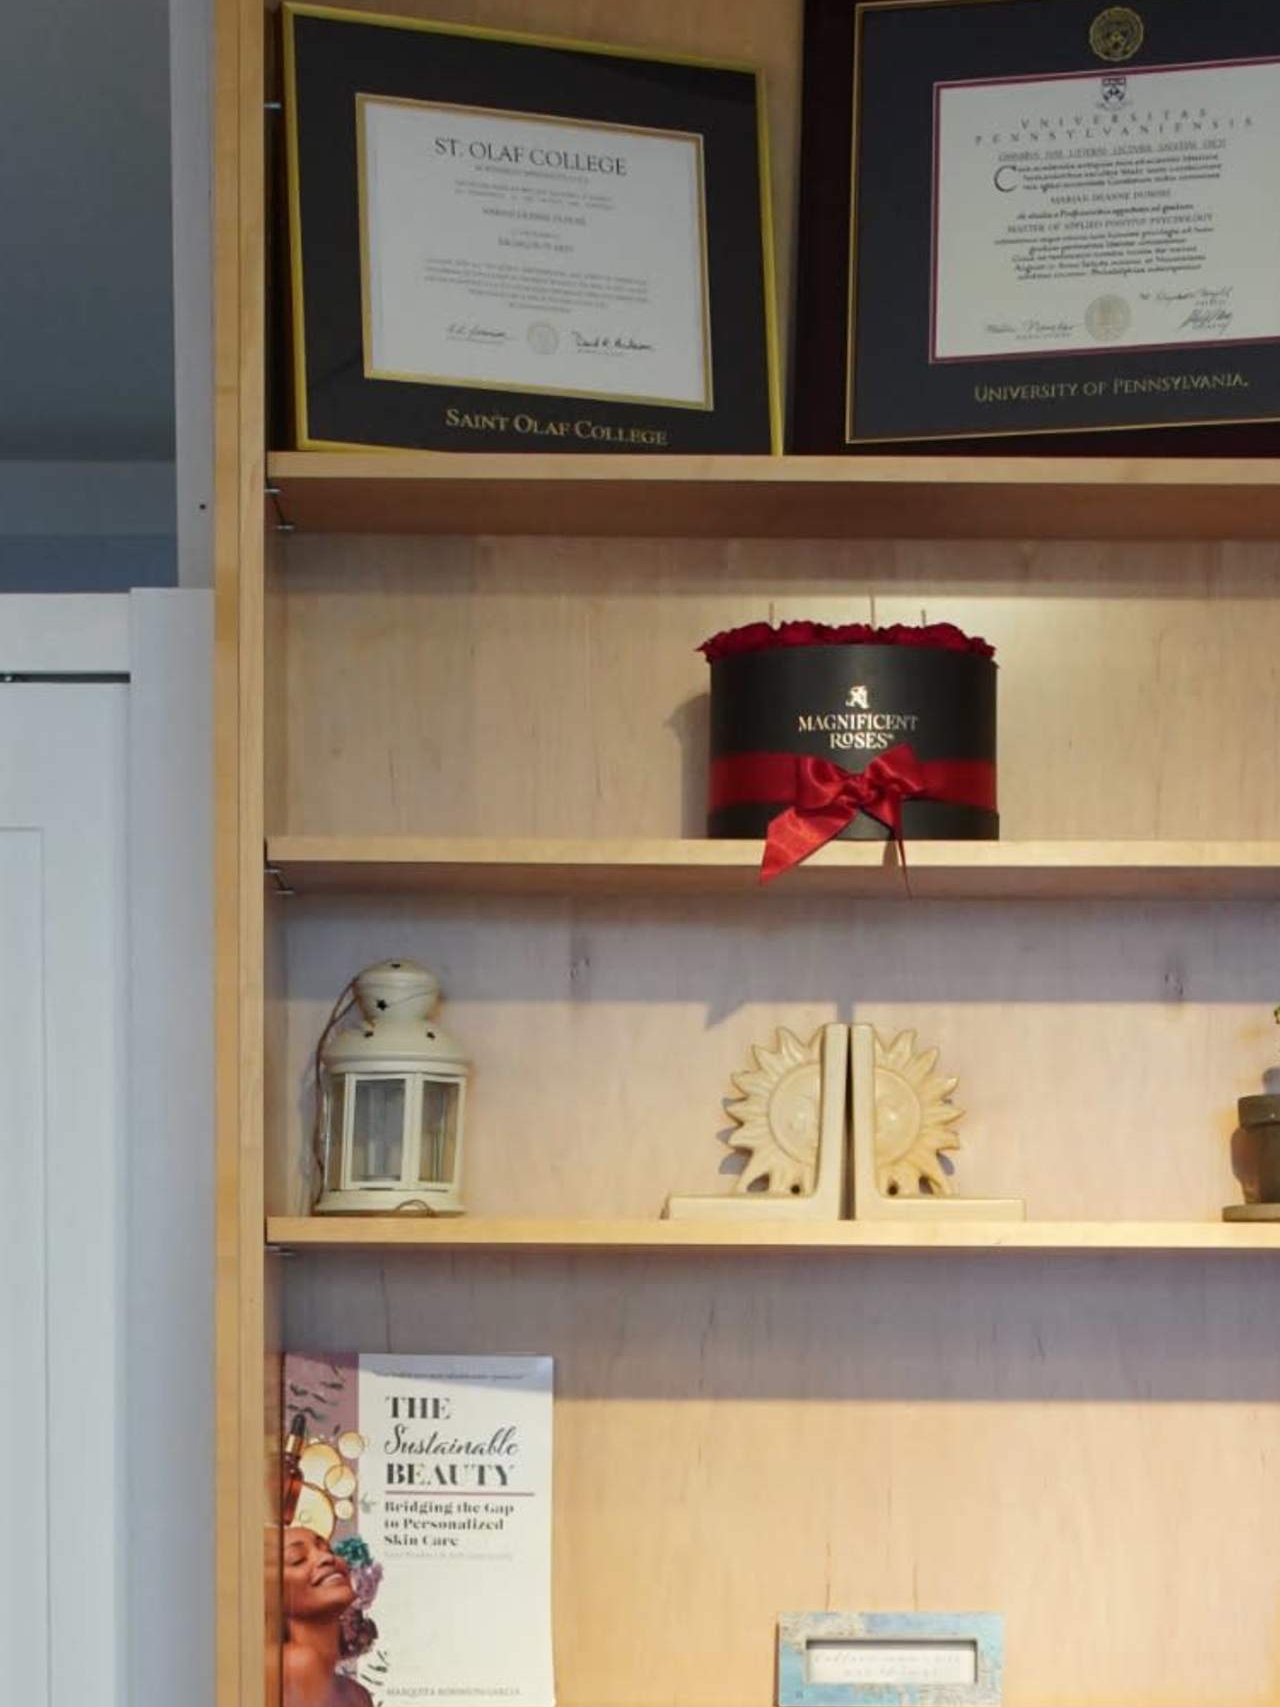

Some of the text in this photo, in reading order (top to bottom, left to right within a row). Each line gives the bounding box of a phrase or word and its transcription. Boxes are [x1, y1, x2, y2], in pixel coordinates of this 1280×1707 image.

[434, 137, 464, 158] ST.
[469, 141, 524, 164] OLAF
[529, 149, 628, 177] COLLEGE
[974, 382, 1078, 402] UNIVERSITY
[1083, 380, 1107, 397] OF
[798, 712, 918, 732] MAGNIFICENT
[385, 1395, 452, 1420] THE
[384, 1423, 518, 1456] Sustainable
[386, 1462, 515, 1487] BEAUTY
[384, 1500, 515, 1517] Bridging the Gap
[384, 1517, 504, 1531] to Personalized
[384, 1533, 460, 1546] Skin Care
